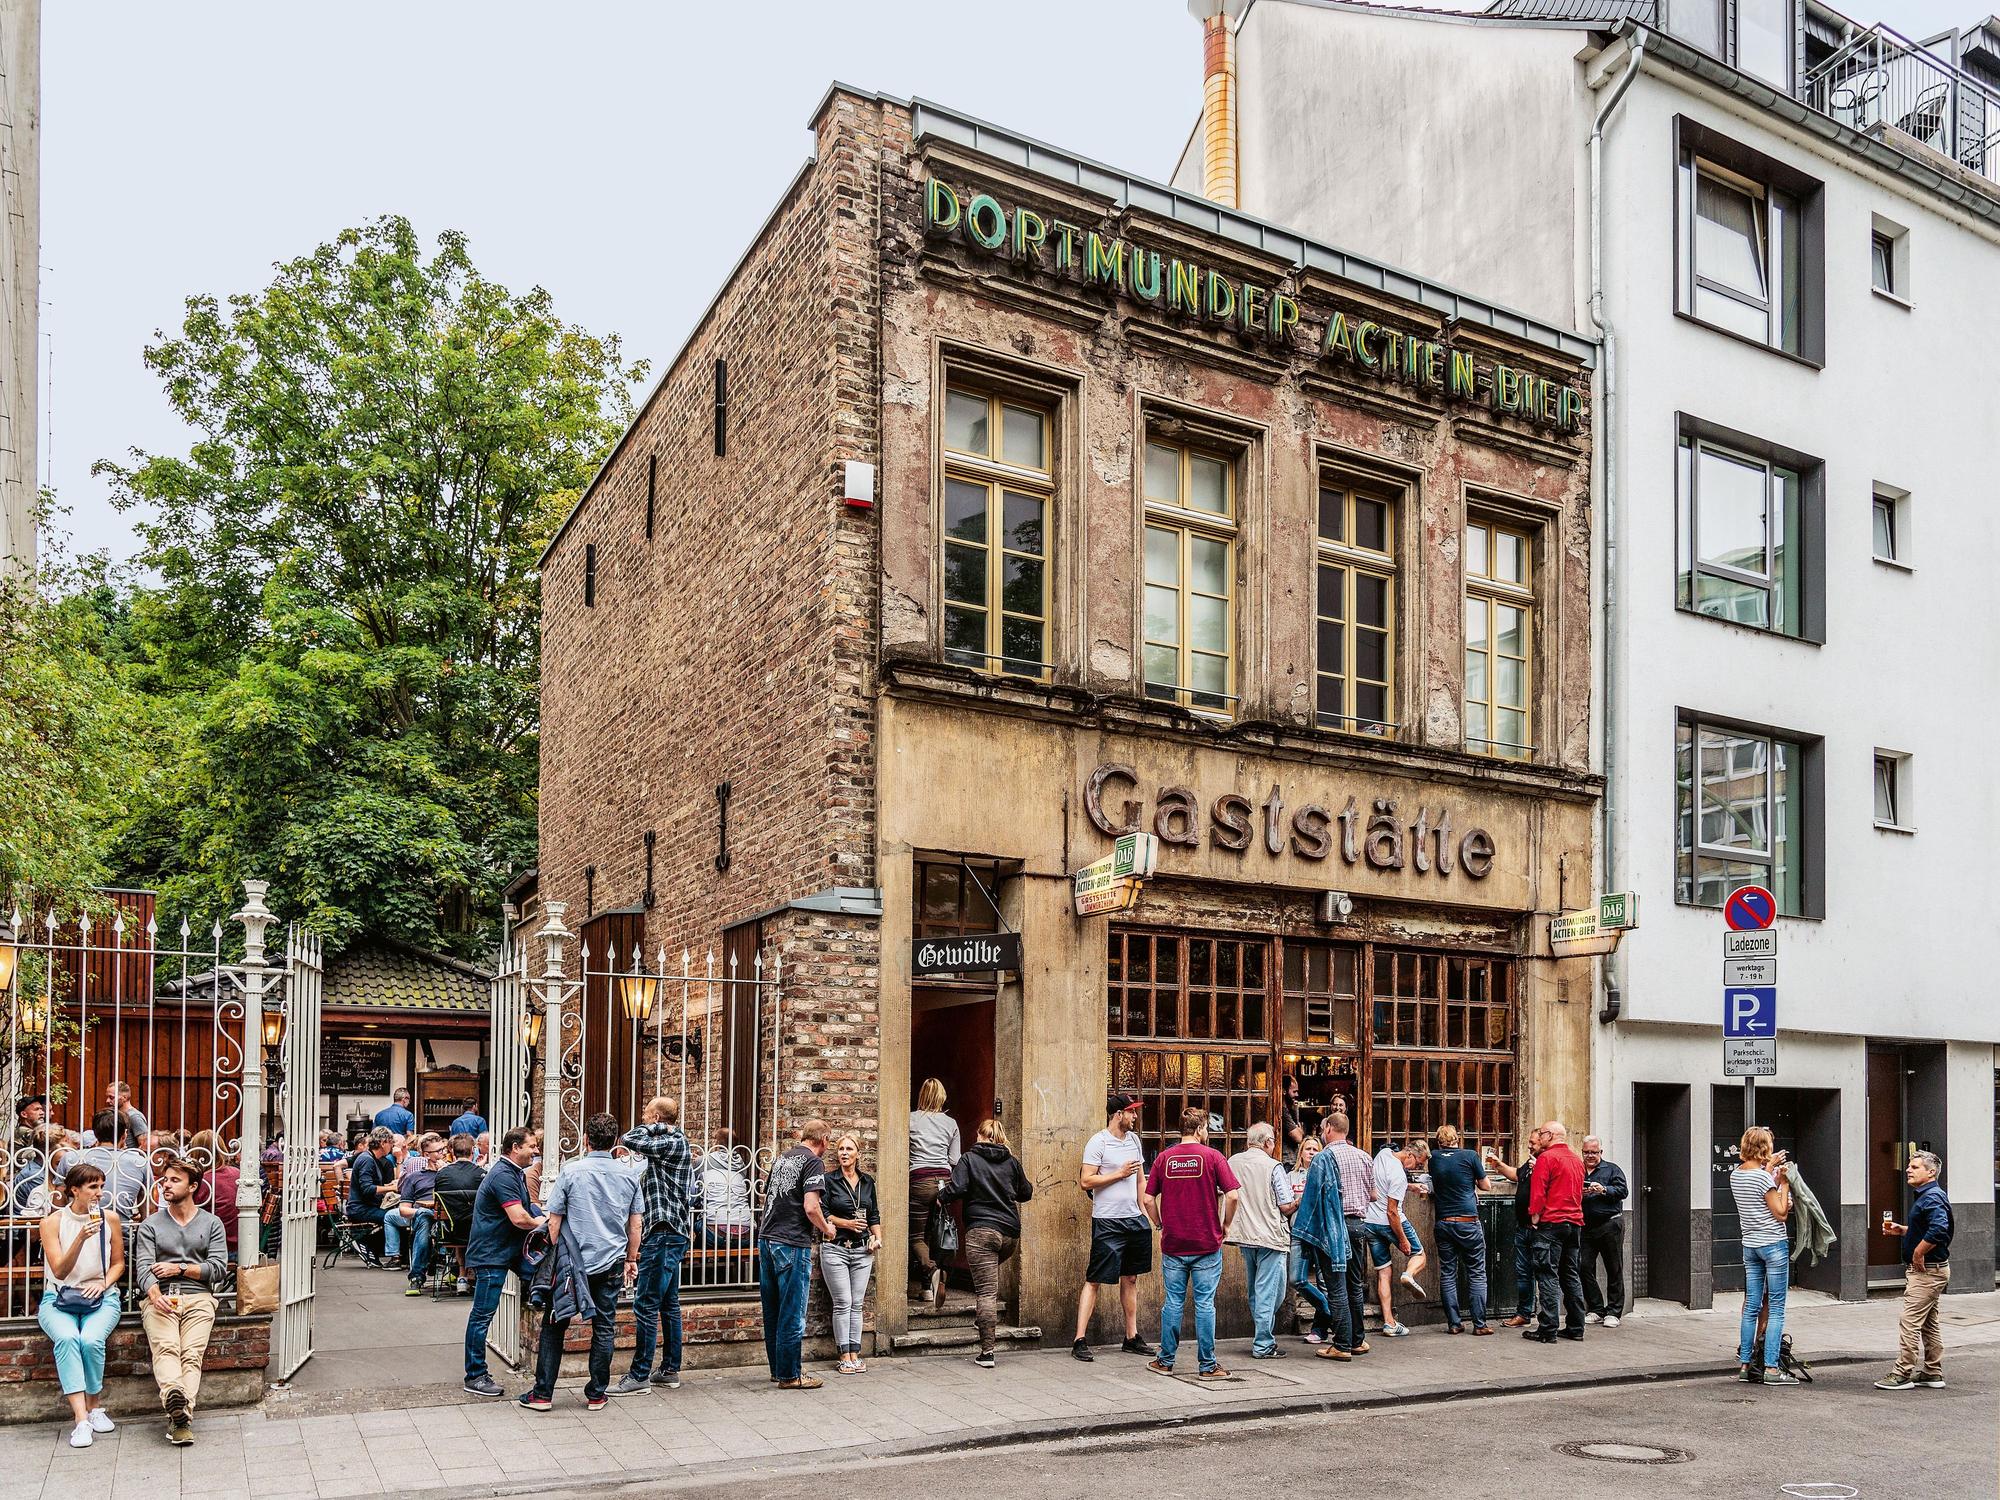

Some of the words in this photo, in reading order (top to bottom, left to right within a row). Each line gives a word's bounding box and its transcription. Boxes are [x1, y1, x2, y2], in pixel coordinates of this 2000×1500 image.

[923, 176, 1300, 348] DORTMUNDER
[1083, 762, 1497, 879] Gaststätte
[1116, 846, 1133, 866] DAB
[1077, 862, 1112, 880] DORTMUNDER
[1603, 903, 1623, 919] DAB
[1553, 915, 1596, 928] DORTMUNDER
[1730, 936, 1770, 951] Ladezone
[918, 940, 1002, 968] Gewölbe
[1736, 964, 1765, 972] werktags
[1732, 994, 1761, 1031] P
[1727, 1066, 1735, 1074] So
